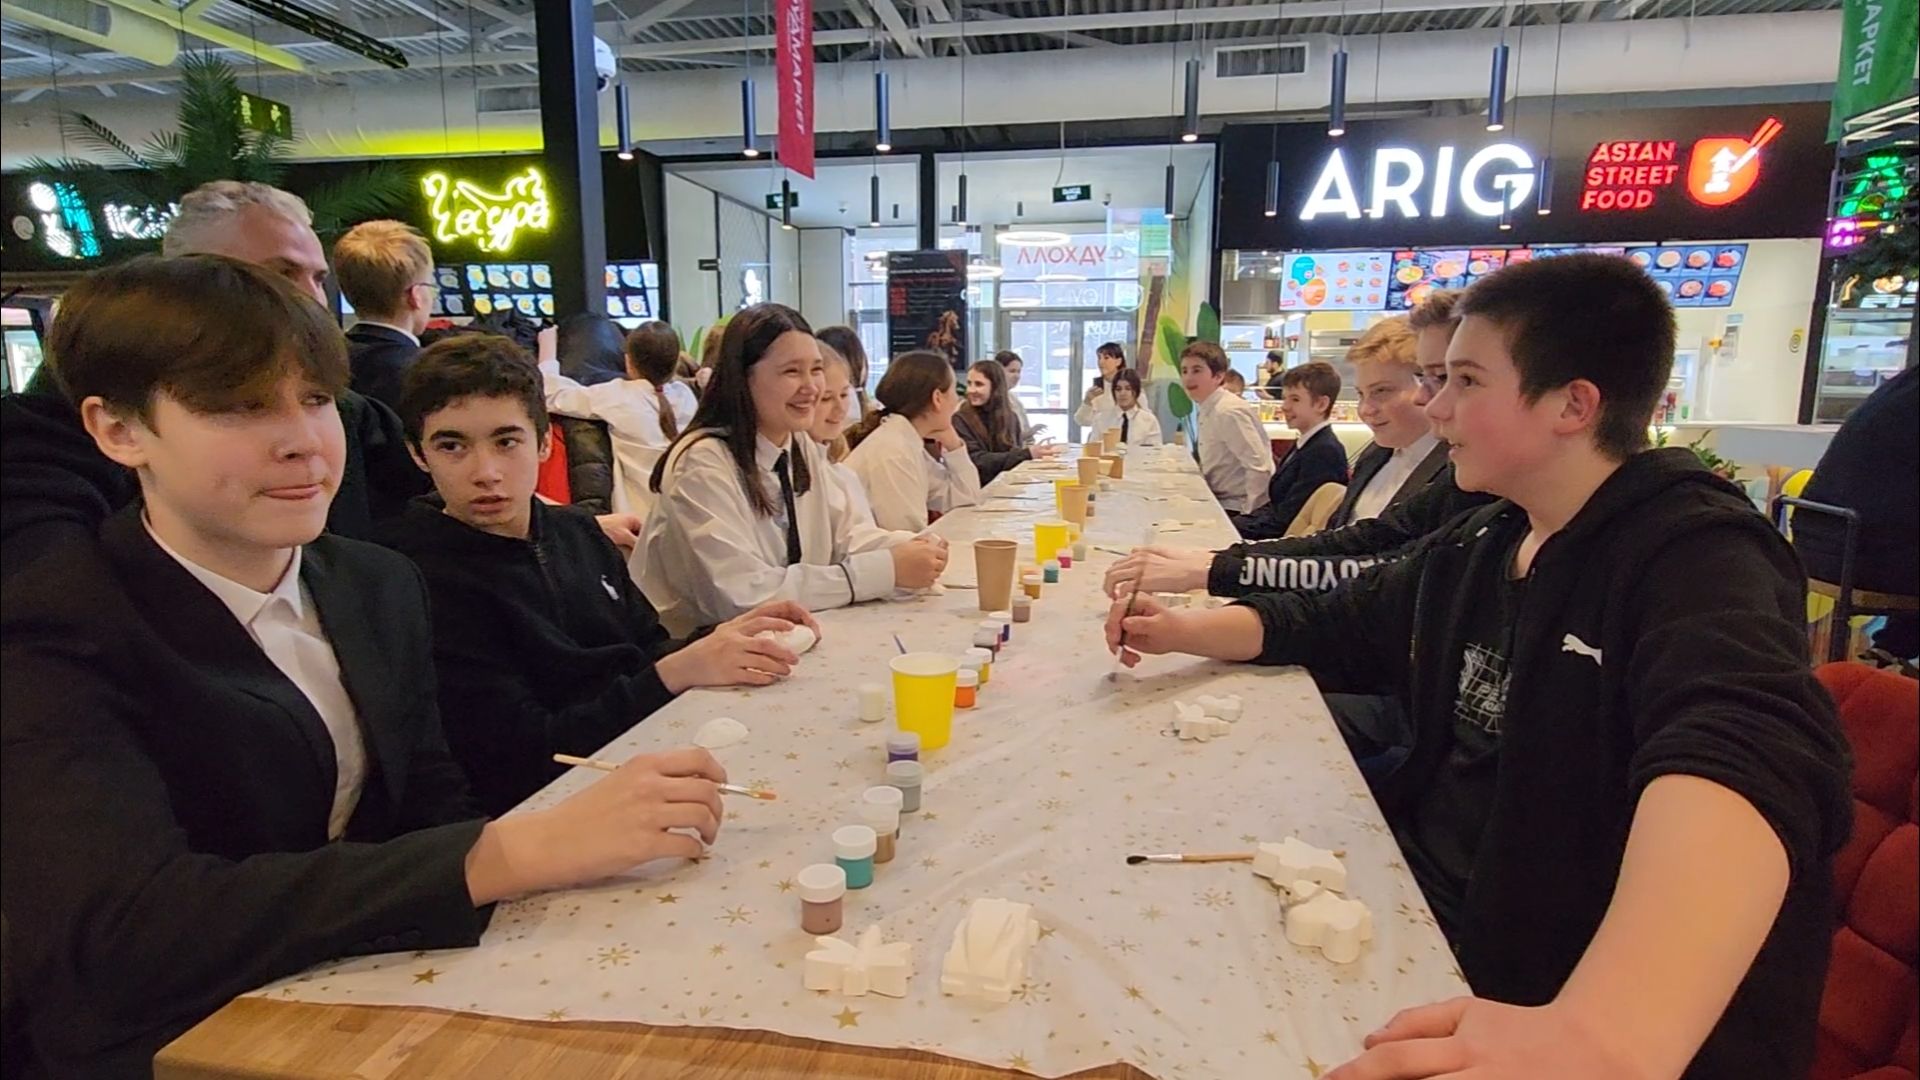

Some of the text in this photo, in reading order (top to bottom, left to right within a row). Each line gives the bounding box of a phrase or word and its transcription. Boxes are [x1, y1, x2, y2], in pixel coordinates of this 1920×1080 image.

[1852, 0, 1882, 86] АРКЕТ
[1592, 141, 1675, 163] ASIAN
[1299, 143, 1535, 219] ARIG
[1587, 165, 1679, 186] STREET
[1582, 189, 1653, 209] FOOD
